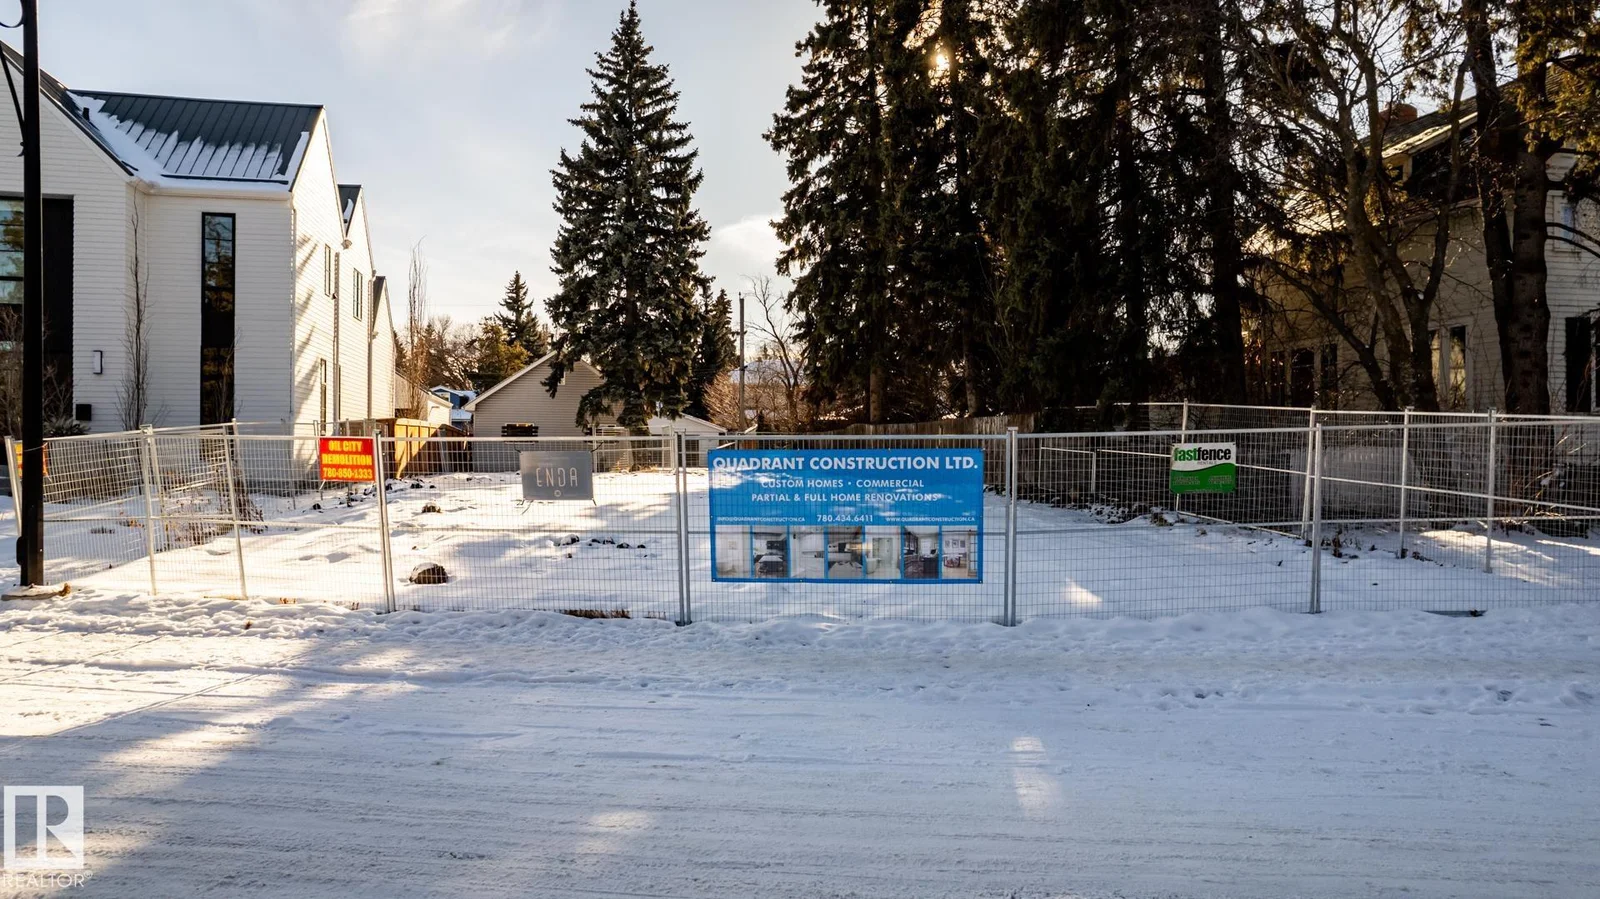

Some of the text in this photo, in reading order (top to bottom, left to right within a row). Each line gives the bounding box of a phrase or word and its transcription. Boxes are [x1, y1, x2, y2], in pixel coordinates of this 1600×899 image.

[328, 440, 363, 452] OIL CITY
[321, 453, 373, 466] DEMOLITION
[1174, 447, 1231, 461] fastfence
[712, 456, 978, 470] QUADRANT CONSTRUCTION LTD.
[322, 467, 373, 479] 780-850-1333
[535, 467, 578, 487] ENDA
[761, 479, 924, 488] CUSTOM HOMES COMMERCIAL
[751, 493, 939, 502] PARTIAL & FULL HOME RENOVATIONS
[816, 514, 873, 522] 780.434.6411
